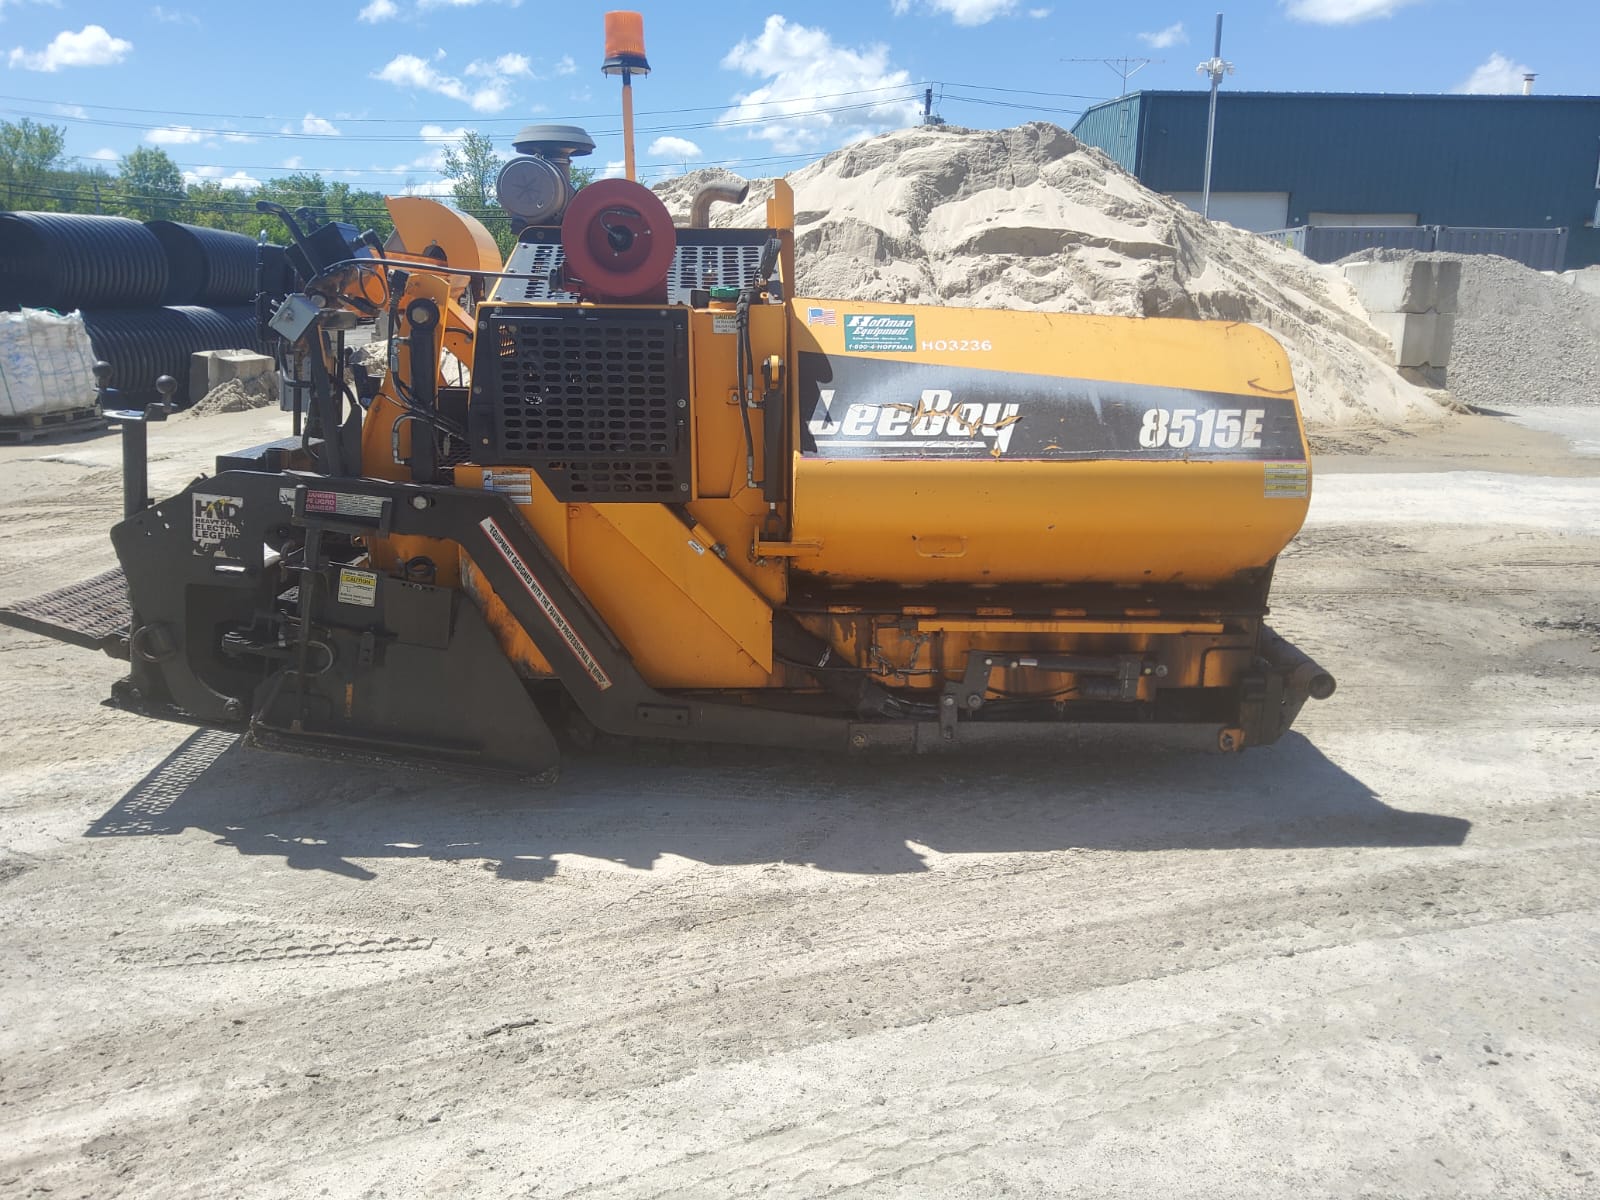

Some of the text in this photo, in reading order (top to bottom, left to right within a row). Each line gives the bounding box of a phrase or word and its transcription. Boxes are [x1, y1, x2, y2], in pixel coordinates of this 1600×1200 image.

[847, 316, 914, 327] Hoffman
[852, 327, 909, 336] Equipment
[807, 389, 1020, 453] LeeBoy
[1139, 409, 1265, 449] 8515E
[345, 576, 371, 585] CAUTION
[511, 557, 533, 585] DESIGNED
[530, 581, 543, 598] WITH
[540, 596, 551, 610] THE
[547, 604, 564, 627] PAVING
[561, 622, 591, 665] PROFESSIONAL
[588, 661, 597, 671] IN
